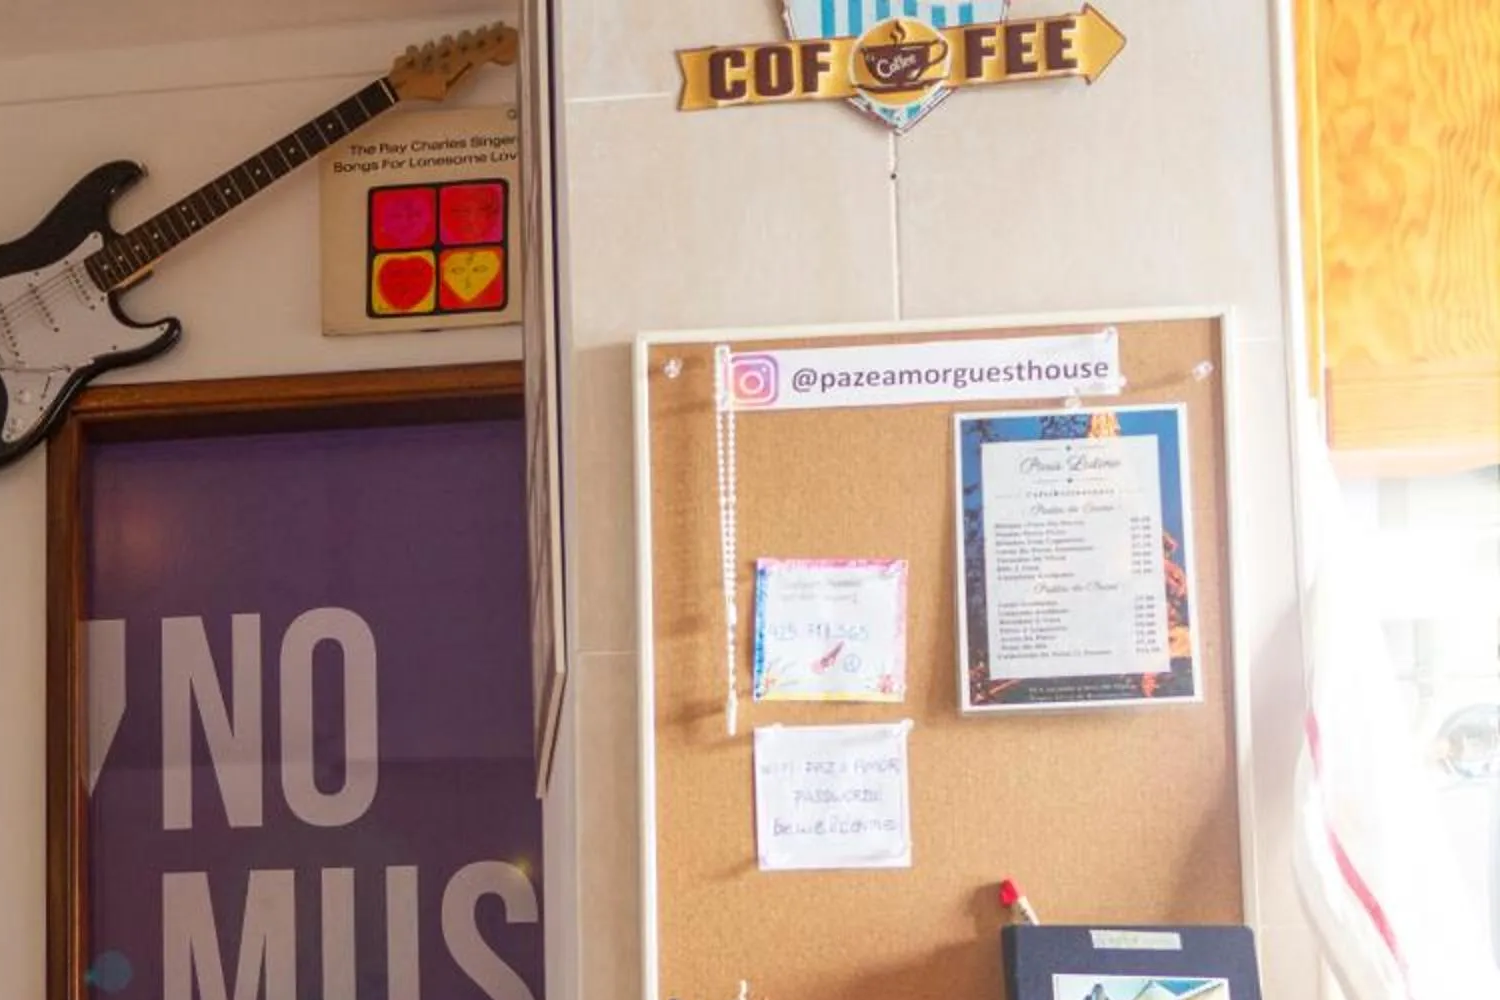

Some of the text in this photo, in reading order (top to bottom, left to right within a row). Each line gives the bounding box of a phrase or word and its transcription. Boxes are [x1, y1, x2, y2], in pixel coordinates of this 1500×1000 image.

[351, 133, 518, 156] The Ray Charles Singer
[381, 157, 405, 169] For
[409, 152, 487, 168] Lonesome
[791, 358, 1110, 394] @pazeamorguesthouse
[161, 606, 379, 831] NO
